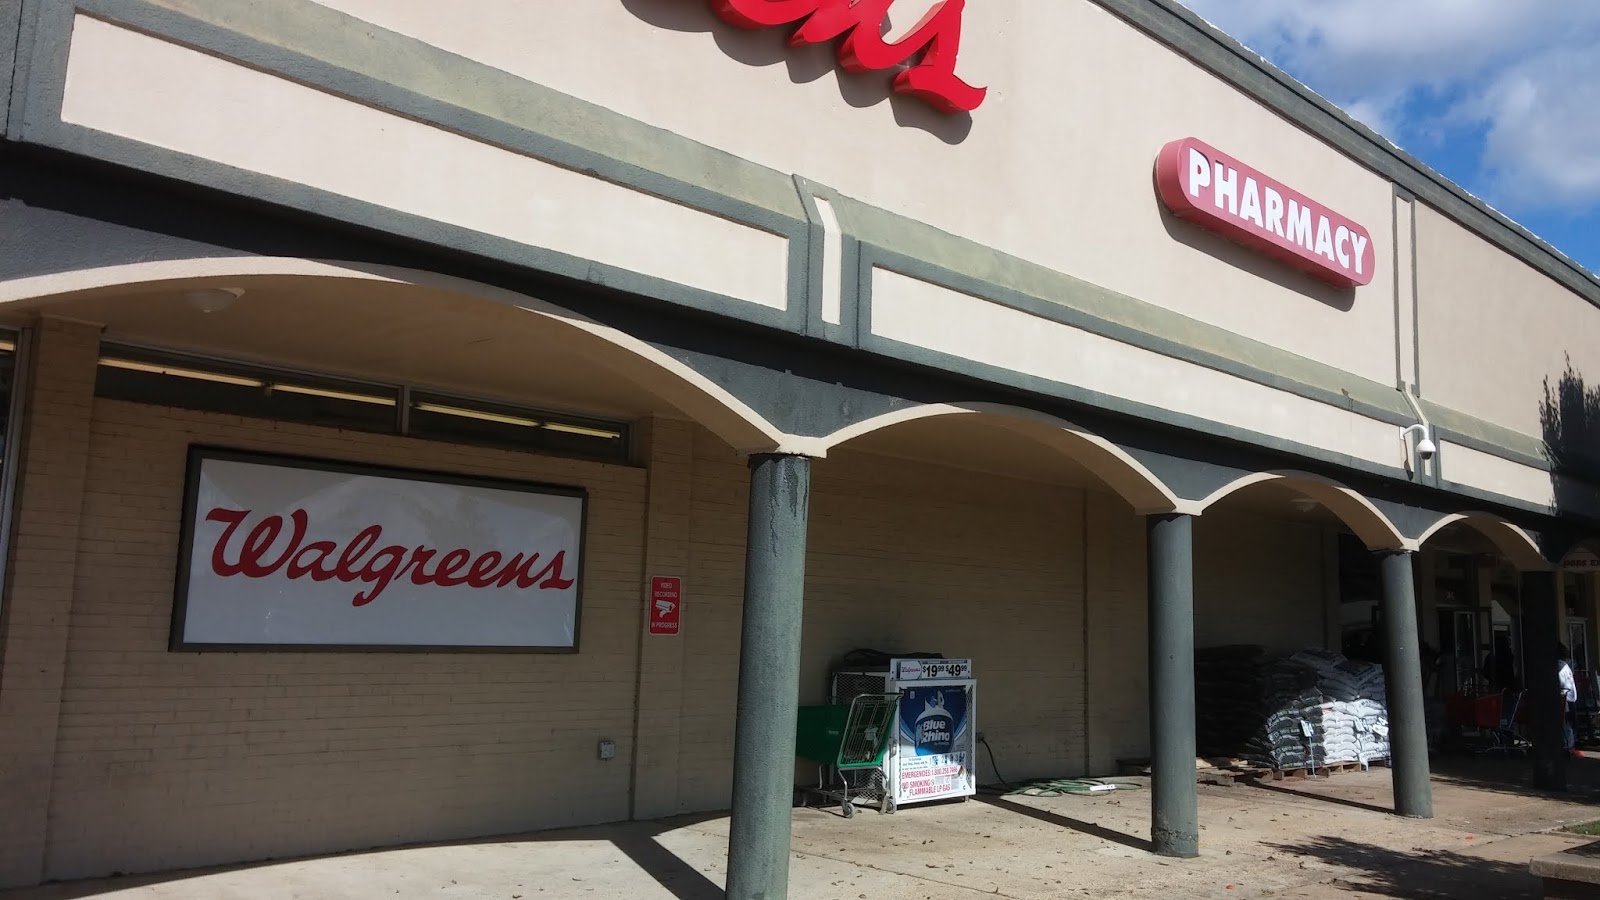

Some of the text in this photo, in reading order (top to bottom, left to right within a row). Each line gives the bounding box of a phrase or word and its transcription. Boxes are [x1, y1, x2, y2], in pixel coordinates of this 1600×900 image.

[1189, 147, 1368, 275] PHARMACY
[205, 507, 575, 607] Walgreens
[923, 720, 946, 731] Blue
[920, 730, 951, 744] Rhino
[909, 779, 931, 789] SMOKING
[909, 785, 936, 796] FLAMMABLE
[942, 784, 951, 792] GAS
